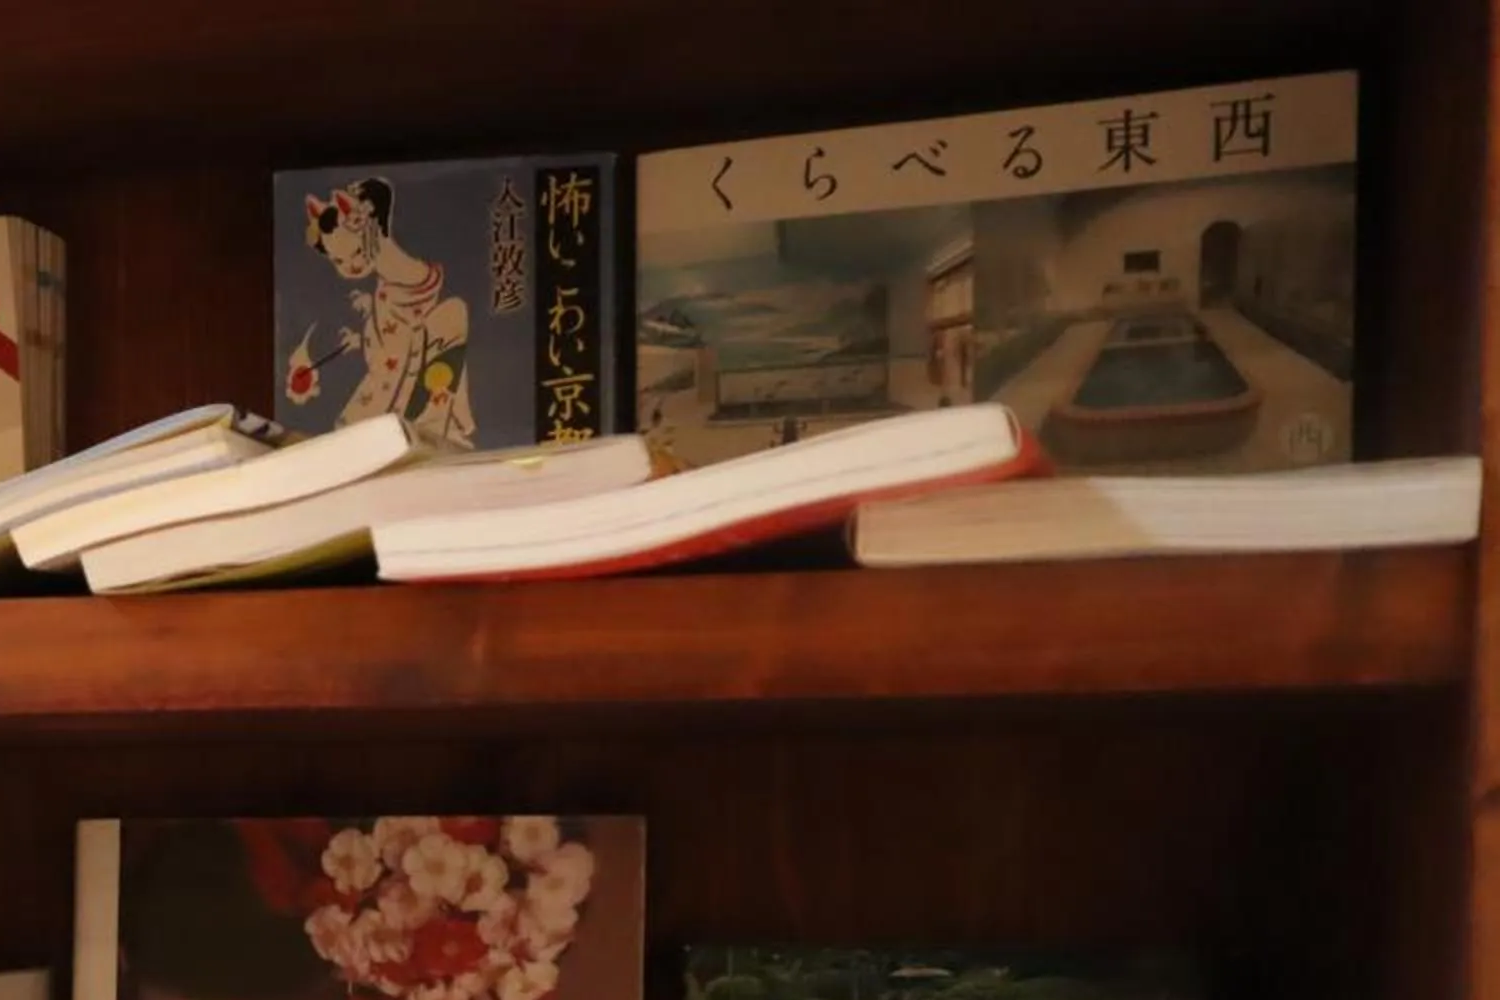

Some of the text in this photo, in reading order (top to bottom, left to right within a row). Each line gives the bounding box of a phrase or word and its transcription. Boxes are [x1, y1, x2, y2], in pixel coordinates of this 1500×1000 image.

[710, 93, 1275, 210] くらべる東西
